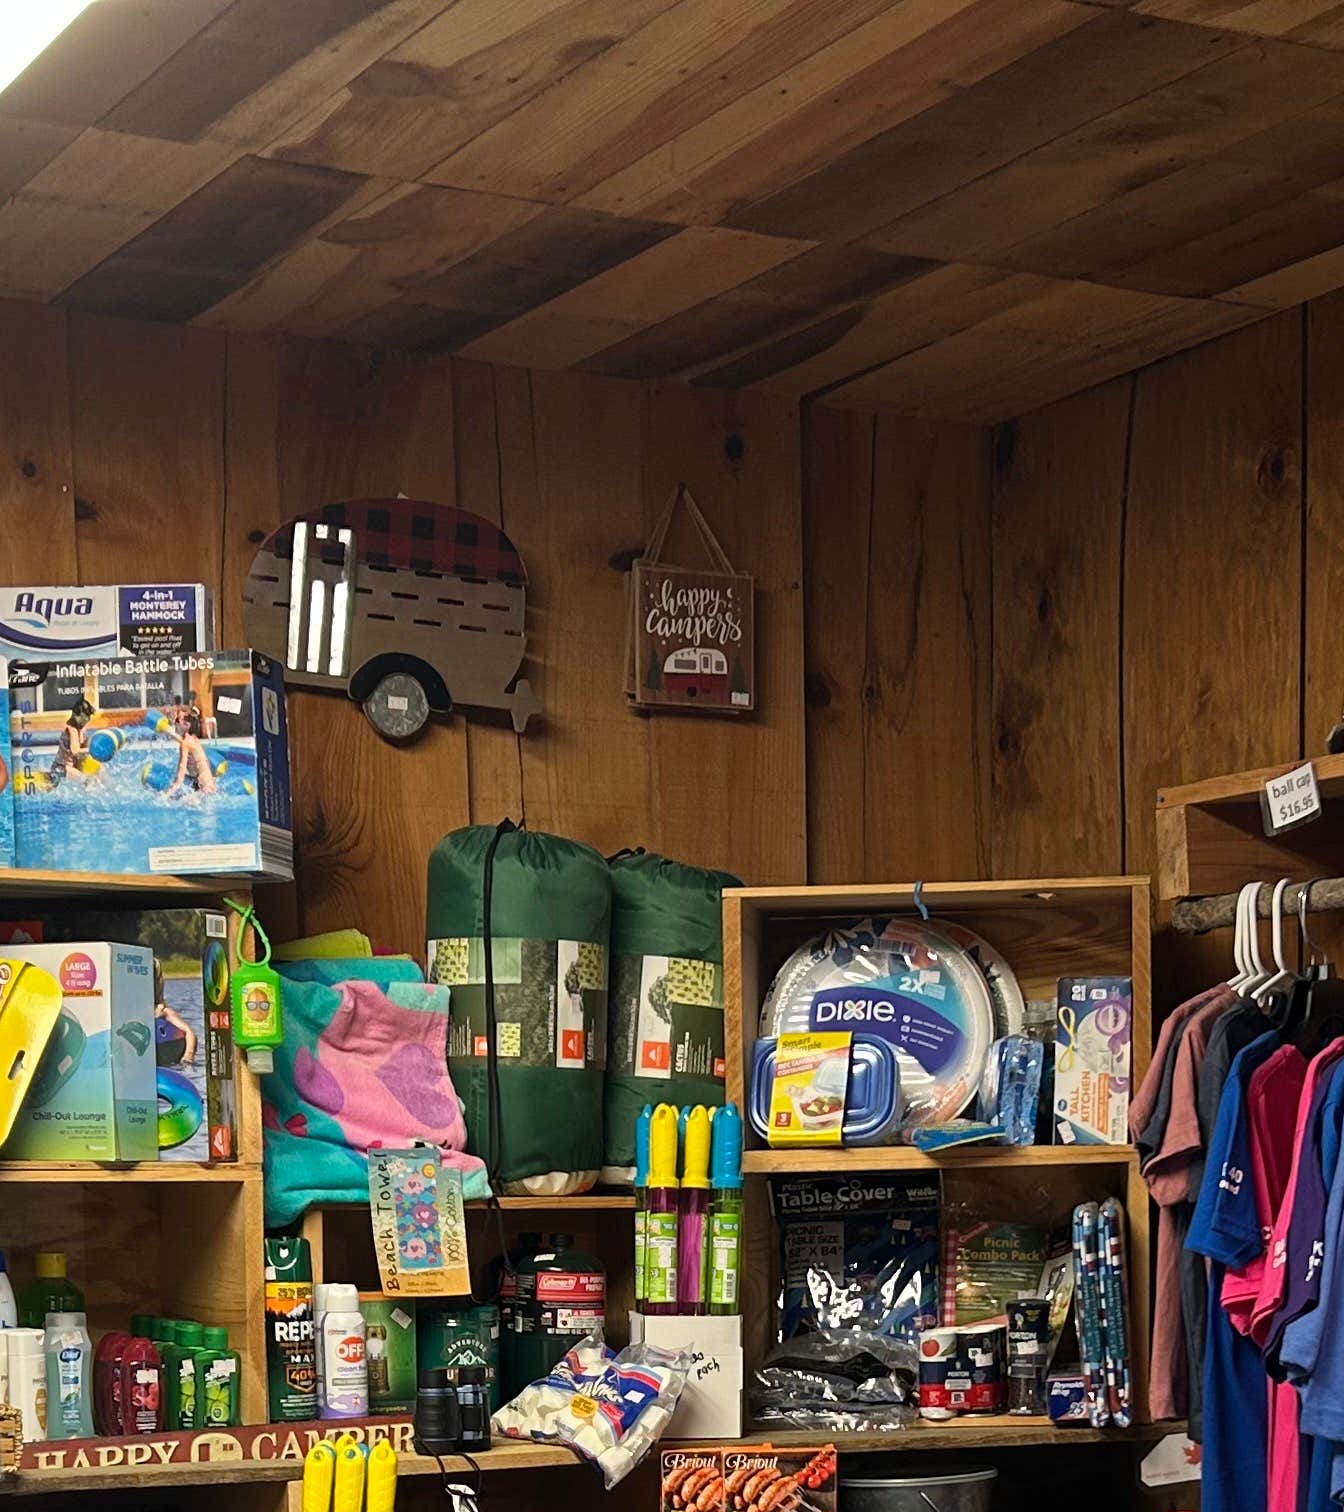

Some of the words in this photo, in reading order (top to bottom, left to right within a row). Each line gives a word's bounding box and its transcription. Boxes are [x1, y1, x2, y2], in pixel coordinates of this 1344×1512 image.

[130, 601, 186, 611] MONTEREY
[658, 579, 723, 617] happy
[14, 593, 93, 625] Aqua
[132, 611, 185, 620] HAMMOCK
[56, 663, 122, 679] Inflatable
[125, 658, 169, 674] Battle
[172, 656, 214, 670] Tubes
[1272, 779, 1294, 798] ball
[1296, 773, 1311, 789] cap
[65, 963, 91, 972] LARGE
[898, 977, 924, 994] 2X
[782, 1037, 811, 1048] Smart
[1070, 1088, 1079, 1116] TALL
[1081, 1071, 1091, 1122] KITCHEN
[33, 1112, 71, 1121] Chill-Out
[73, 1112, 106, 1122] Lounge
[373, 1153, 393, 1216] Towel
[778, 1188, 832, 1207] Table
[837, 1186, 895, 1202] Cover
[984, 1237, 1020, 1248] Picnic
[380, 1227, 400, 1291] Beach
[961, 1250, 1008, 1261] Combo
[1011, 1250, 1040, 1261] Pack
[697, 1359, 720, 1380] each
